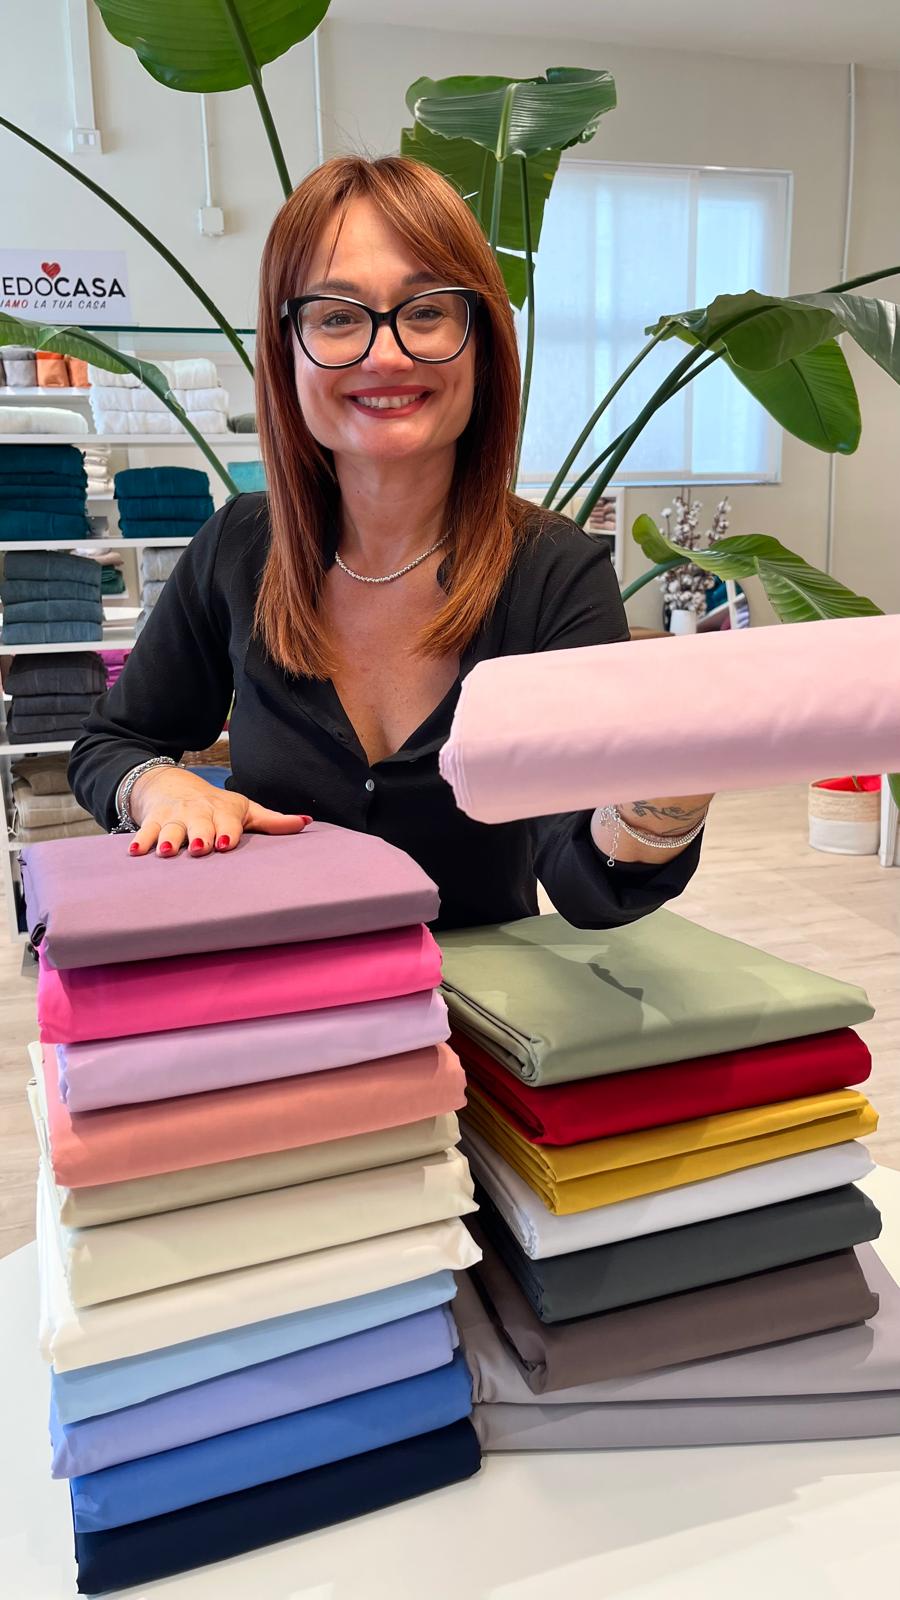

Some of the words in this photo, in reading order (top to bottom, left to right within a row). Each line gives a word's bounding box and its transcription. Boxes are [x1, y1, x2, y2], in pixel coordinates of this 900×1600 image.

[2, 277, 126, 298] EDOCASA
[34, 300, 47, 309] LA
[52, 300, 73, 309] TUA
[78, 300, 107, 310] CASA
